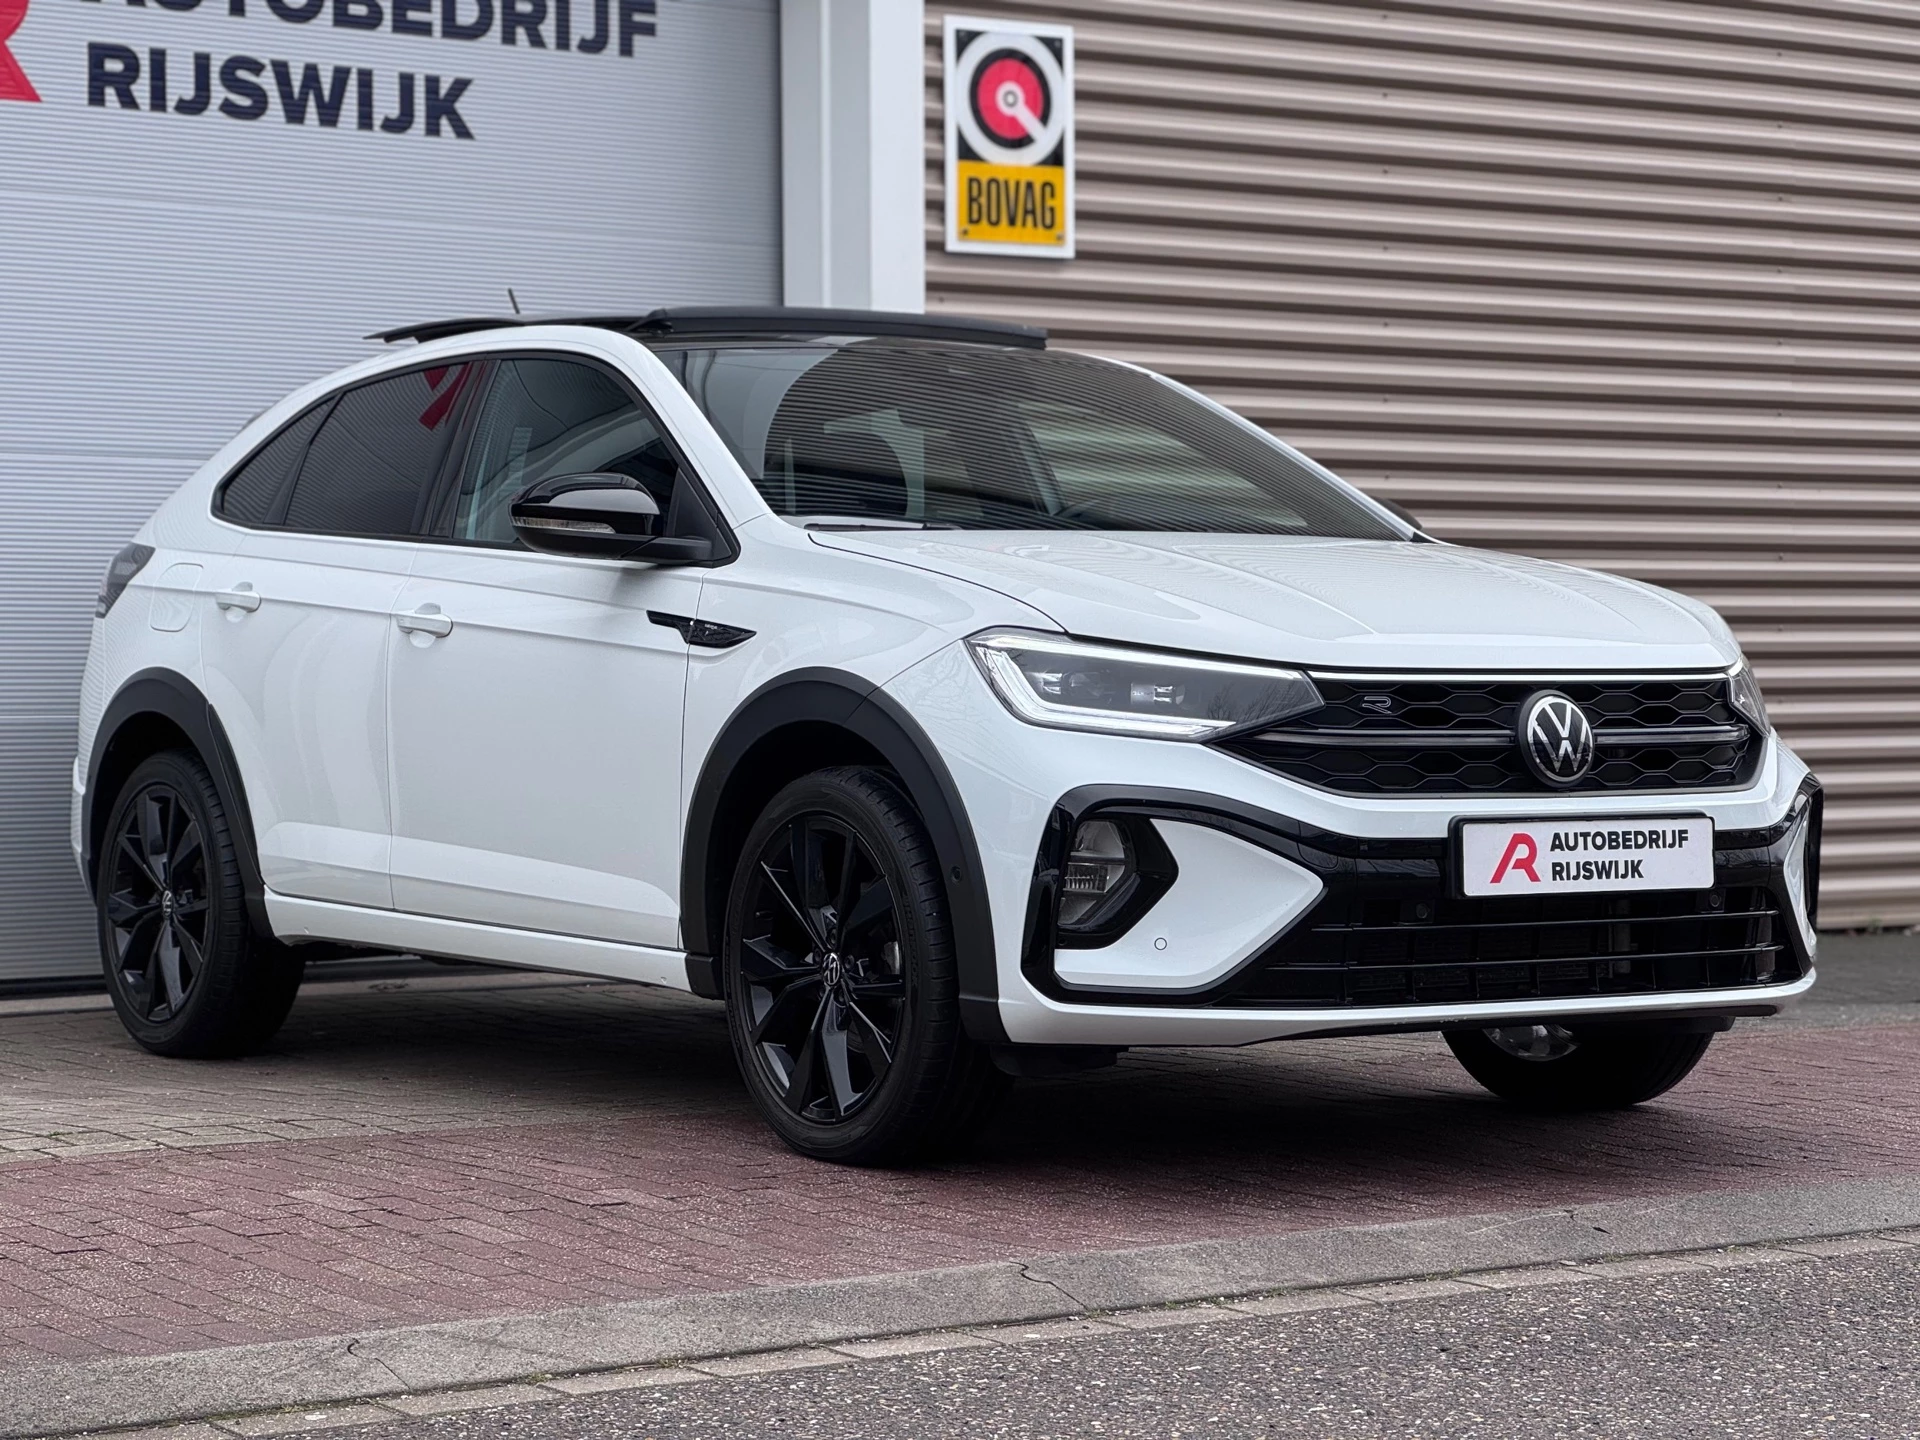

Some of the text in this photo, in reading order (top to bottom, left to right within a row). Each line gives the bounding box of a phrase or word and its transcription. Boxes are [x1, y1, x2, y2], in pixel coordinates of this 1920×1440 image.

[81, 0, 657, 57] EDRIJF
[87, 42, 475, 140] RIJSWIJK
[967, 177, 1055, 230] BOVAG
[1550, 829, 1689, 852] AUTOBEDRIJF
[1551, 859, 1644, 881] RIJSWIJK
